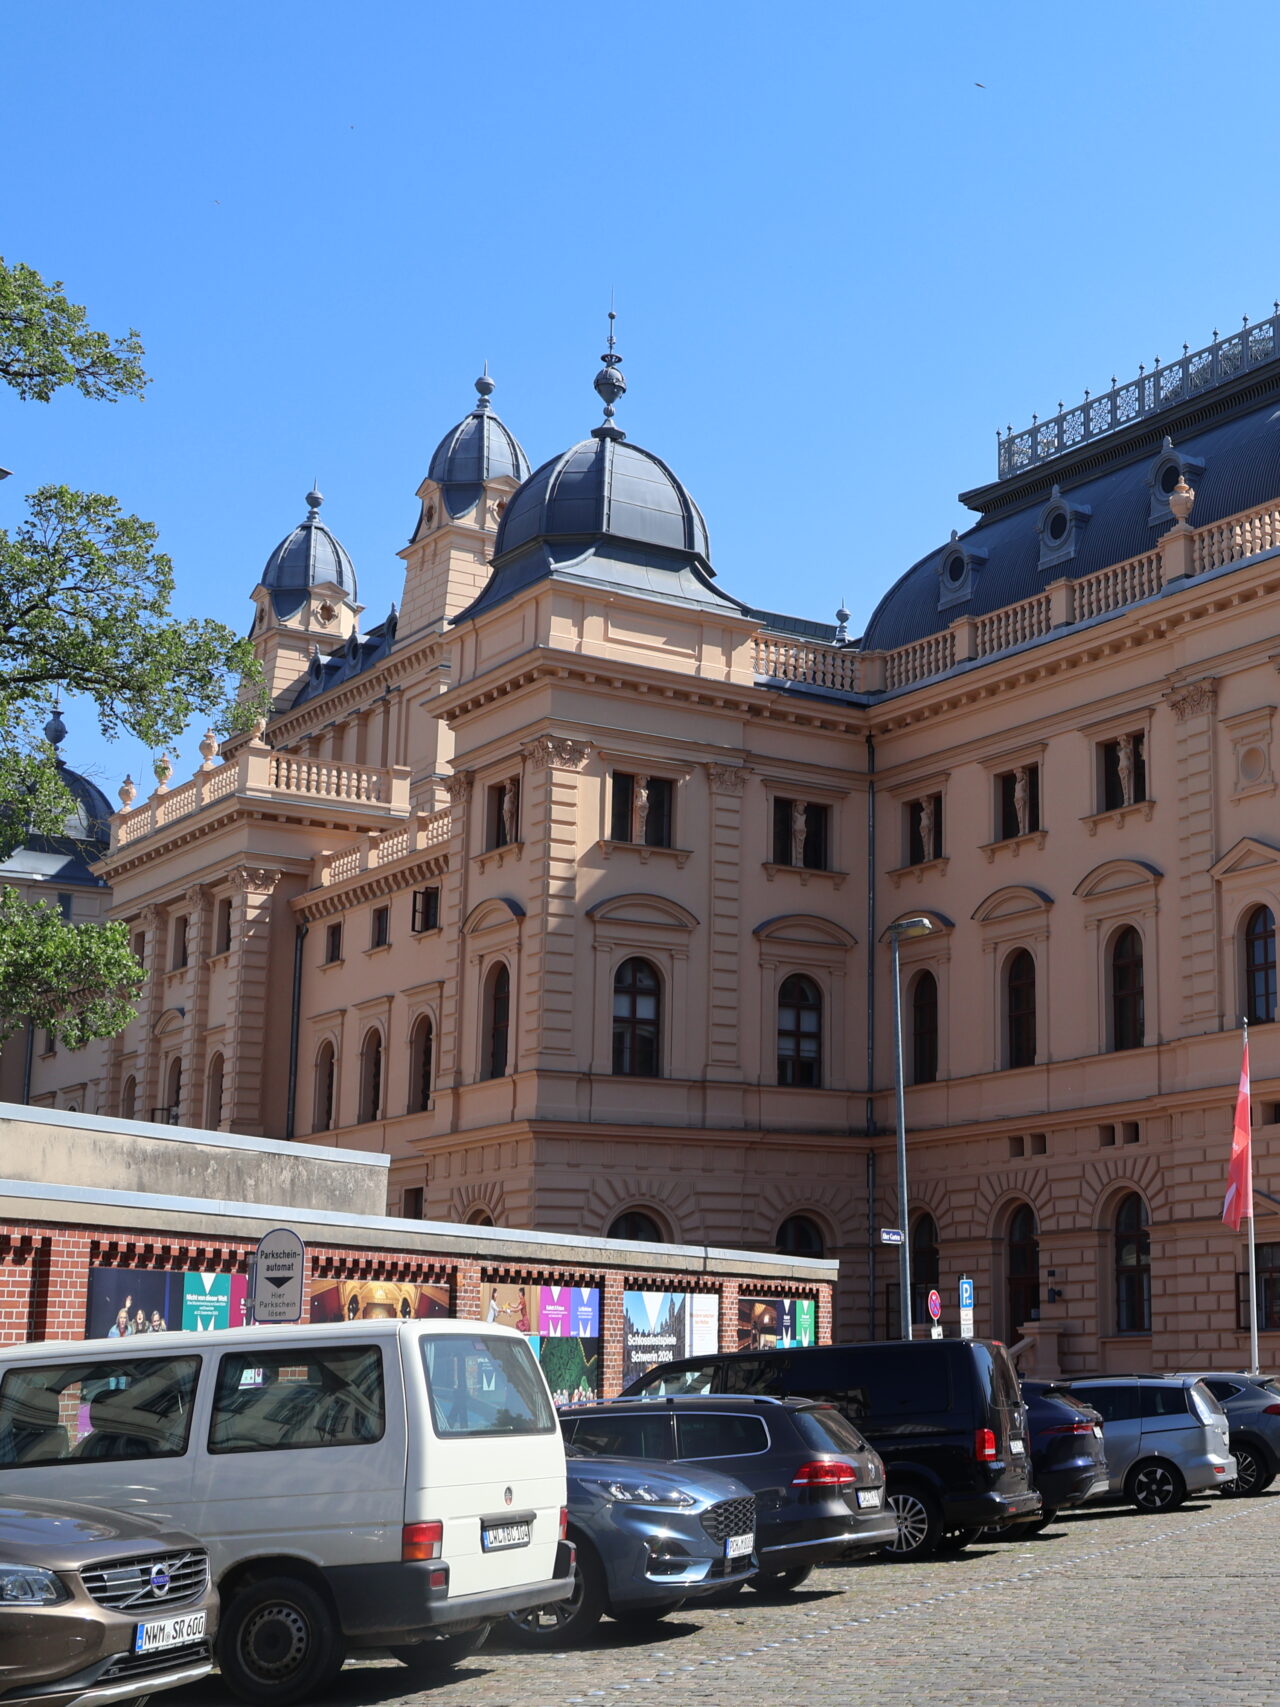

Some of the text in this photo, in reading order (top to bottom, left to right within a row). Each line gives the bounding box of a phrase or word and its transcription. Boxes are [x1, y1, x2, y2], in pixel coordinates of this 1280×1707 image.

[260, 1250, 301, 1259] Parkschein-
[266, 1263, 294, 1271] automat
[259, 1301, 296, 1309] Parkschein
[628, 1334, 677, 1347] Schlossfestspiele
[631, 1350, 673, 1362] Schwerin 2024
[145, 1624, 166, 1646] NWM
